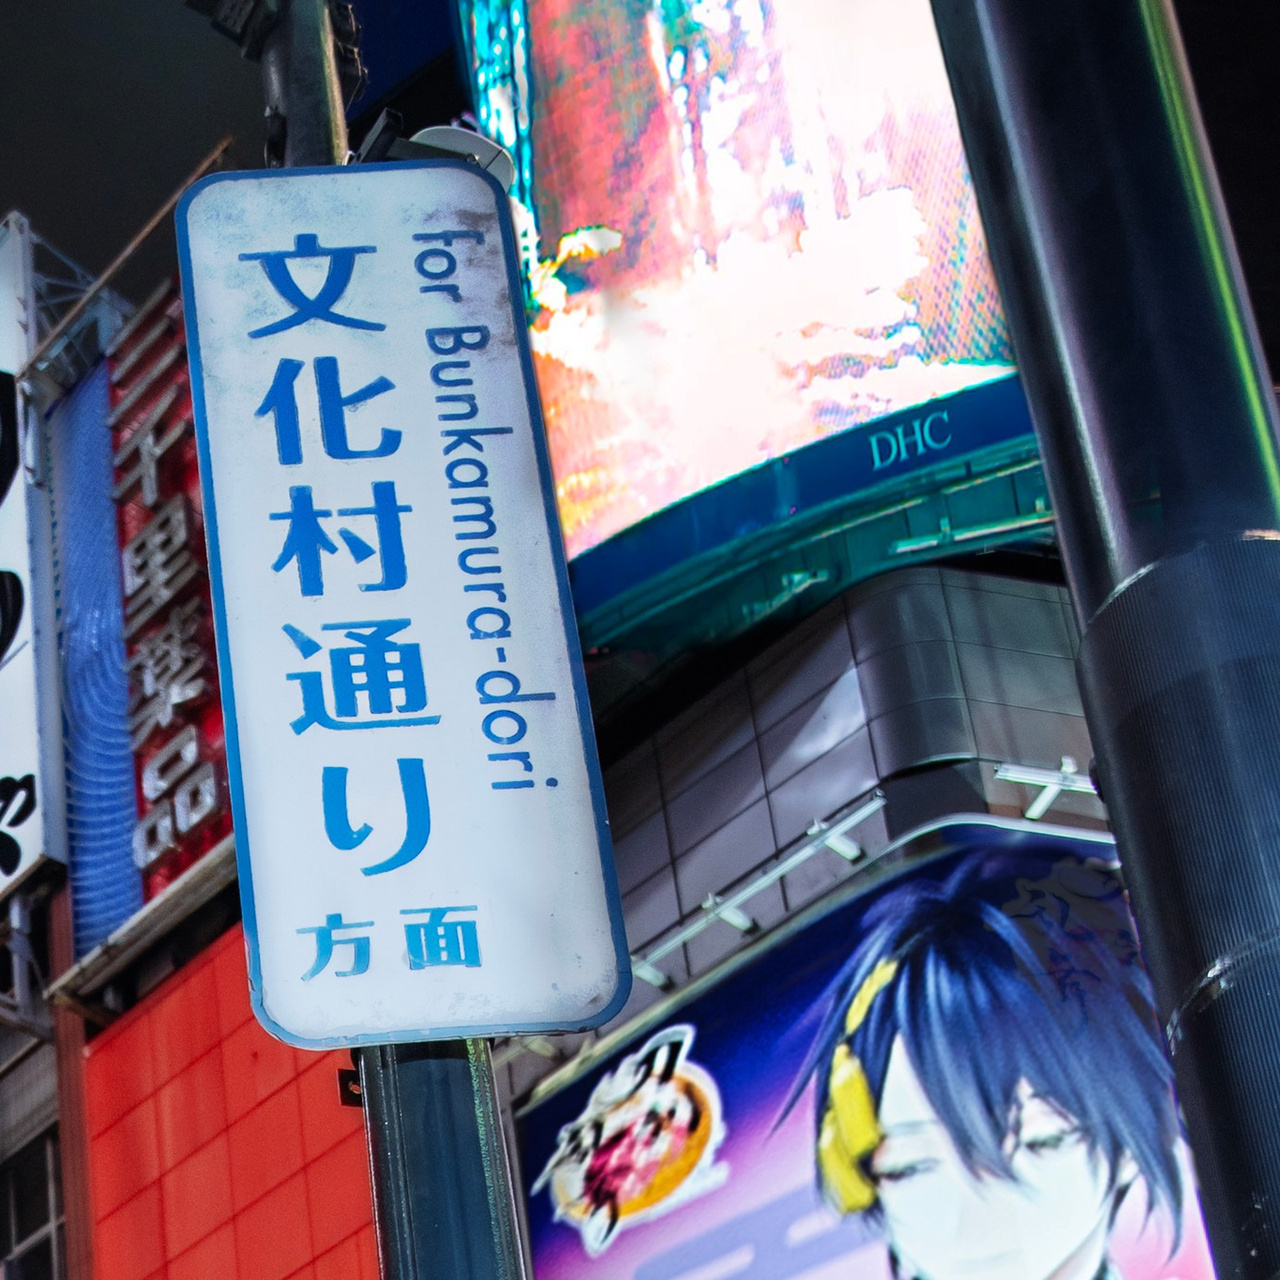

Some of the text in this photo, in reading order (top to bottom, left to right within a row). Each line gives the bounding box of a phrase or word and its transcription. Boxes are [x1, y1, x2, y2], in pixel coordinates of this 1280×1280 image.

[238, 233, 442, 878] 文化村通り
[412, 228, 559, 793] for Bunkamura-dori
[870, 409, 953, 474] DHC
[294, 904, 484, 984] 方面
